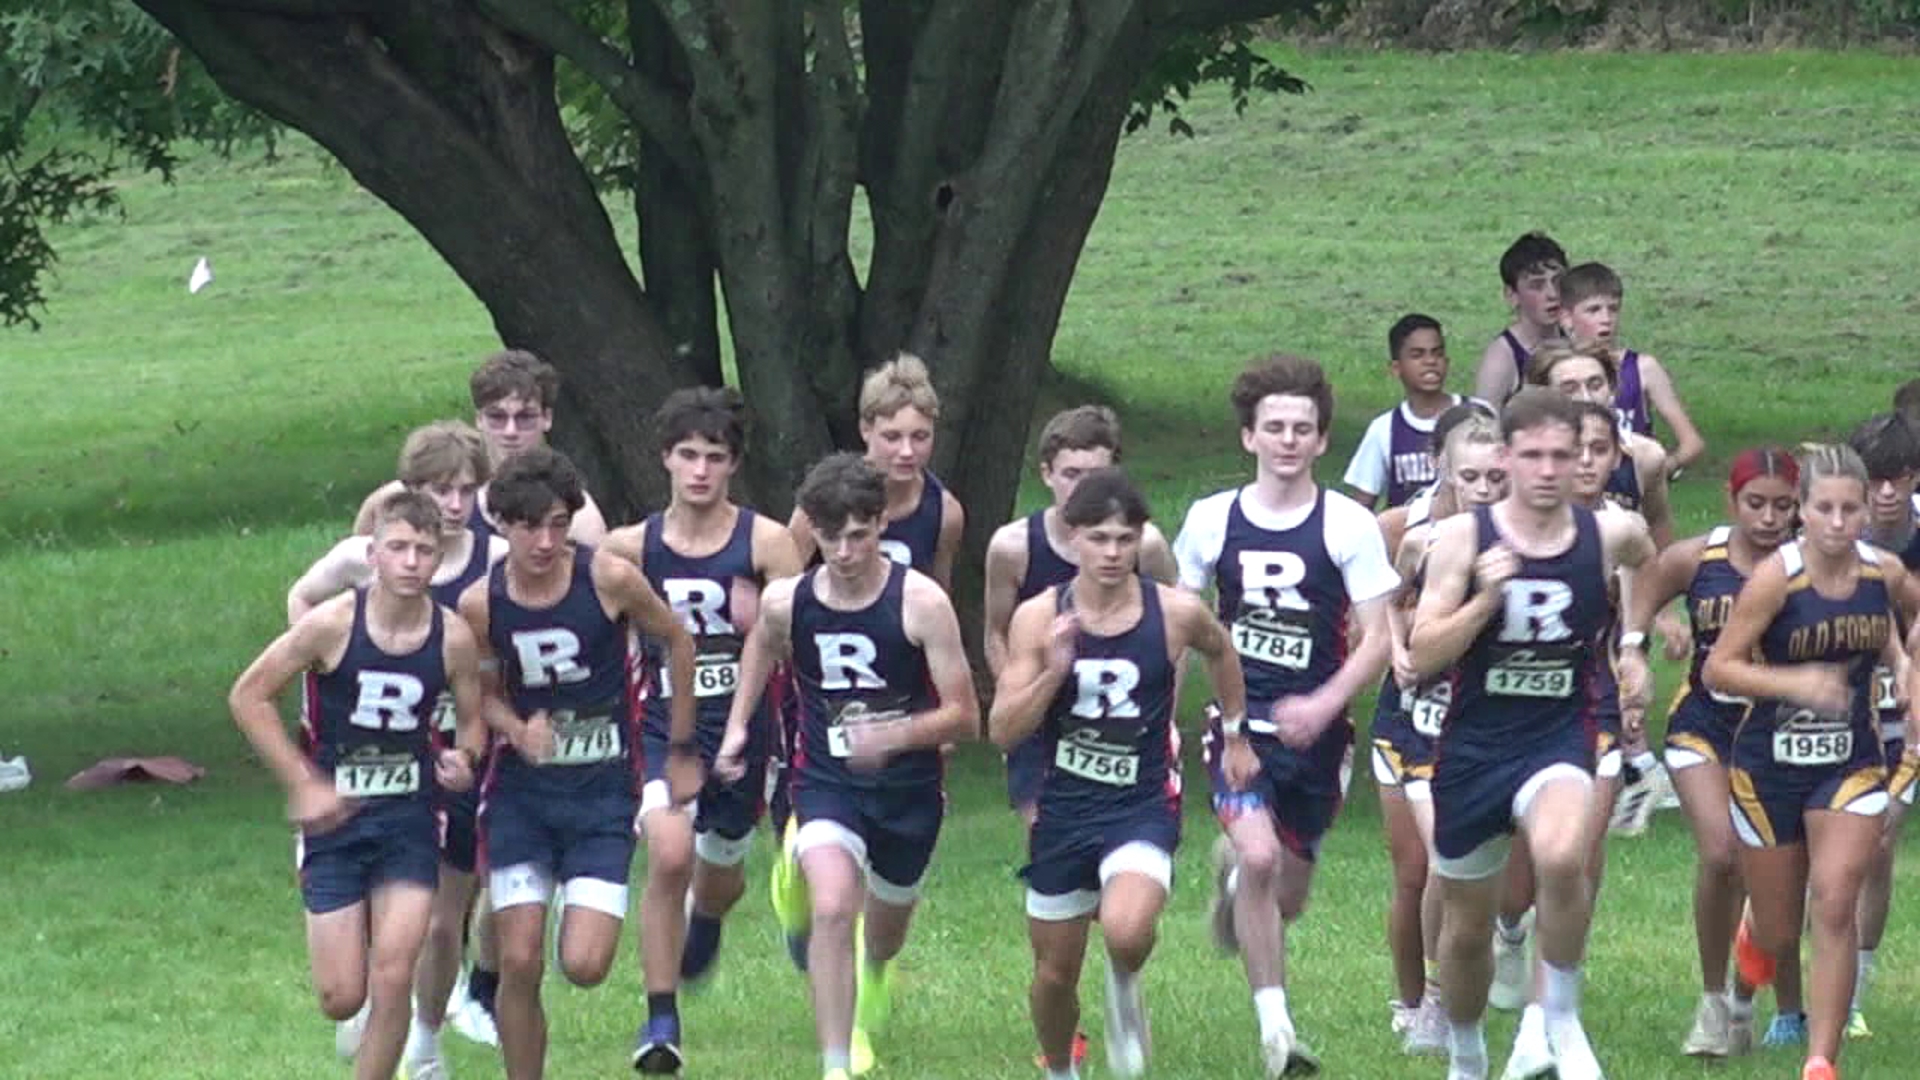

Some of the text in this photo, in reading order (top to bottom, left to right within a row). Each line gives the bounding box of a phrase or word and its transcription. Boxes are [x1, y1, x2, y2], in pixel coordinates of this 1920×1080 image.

[1238, 550, 1310, 610] R
[663, 578, 734, 634] R
[1498, 578, 1573, 642] R
[512, 627, 590, 688] R
[814, 633, 886, 690] R
[1237, 630, 1304, 660] 1784
[1788, 620, 1829, 658] OLD
[350, 670, 424, 731] R
[699, 665, 735, 690] 68
[1071, 659, 1141, 719] R
[1495, 672, 1566, 692] 1759
[1064, 747, 1132, 778] 1756
[1779, 734, 1849, 757] 1958
[343, 766, 412, 790] 1774
